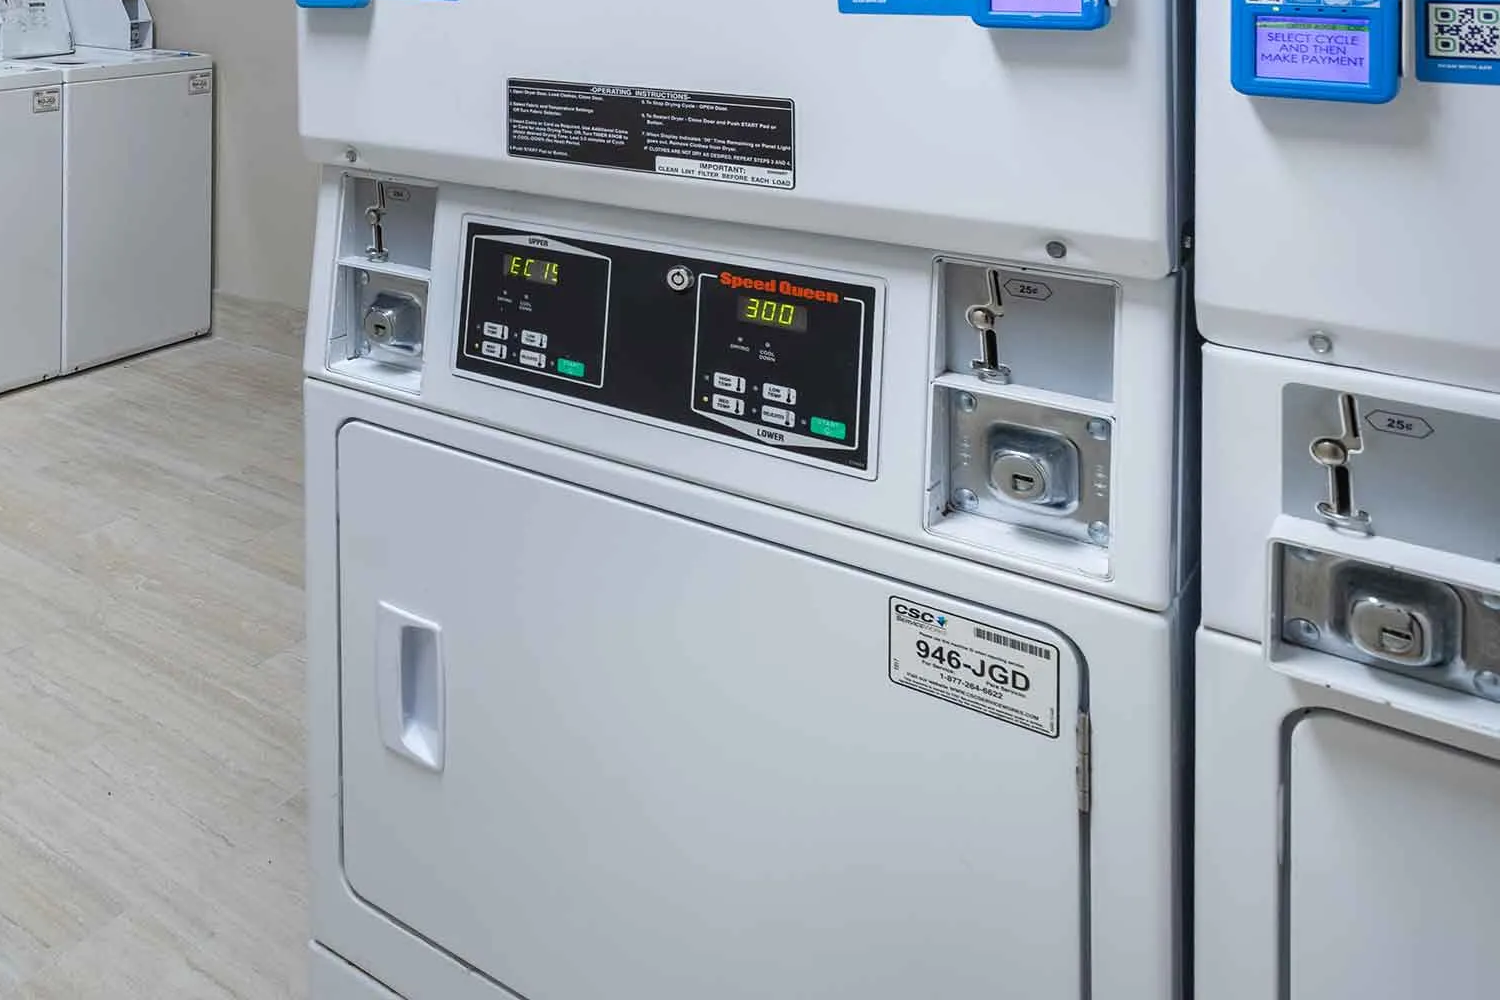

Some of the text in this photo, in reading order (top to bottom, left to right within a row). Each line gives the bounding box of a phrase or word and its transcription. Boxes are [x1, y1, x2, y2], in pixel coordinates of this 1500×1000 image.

[1267, 32, 1360, 46] SELECT CYCLE
[1279, 43, 1347, 56] AND THEN
[1260, 53, 1365, 67] MAKE PAYMENT
[699, 162, 746, 174] IMPORTANT:
[658, 165, 679, 174] CLEAN
[698, 170, 719, 178] FILTER
[722, 173, 748, 182] BEFORE
[751, 176, 770, 184] EACH
[772, 178, 791, 186] LOAD
[528, 237, 548, 247] UPPER
[719, 271, 840, 304] Speed Queen
[747, 298, 794, 325] 300
[759, 350, 775, 358] COOL
[718, 380, 732, 388] TEMP
[768, 386, 781, 394] LOW
[767, 391, 782, 399] TEMP
[1386, 416, 1413, 432] 25¢
[756, 428, 785, 442] LOWER
[894, 604, 935, 623] CSC
[915, 639, 1031, 692] 946-JGD
